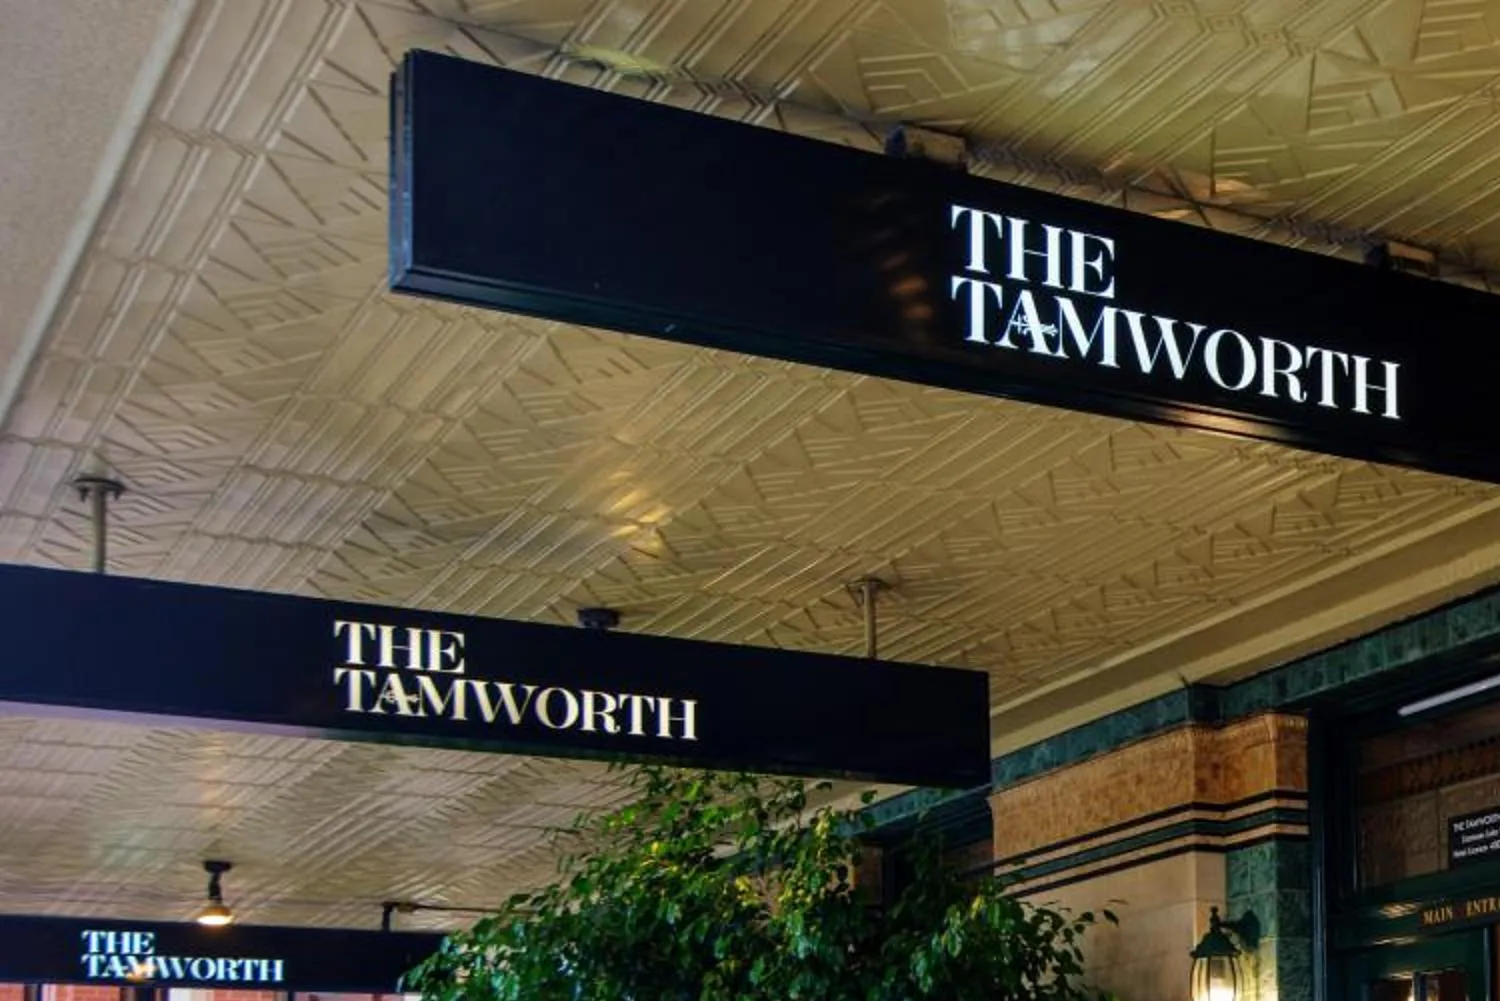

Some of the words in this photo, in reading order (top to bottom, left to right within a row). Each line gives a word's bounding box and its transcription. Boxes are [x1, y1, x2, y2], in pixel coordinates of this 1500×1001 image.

[951, 205, 1115, 299] THE
[951, 275, 1401, 421] TAMWORTH
[334, 620, 465, 674] THE
[334, 667, 698, 741] TAMWORTH
[82, 929, 156, 955] THE
[1422, 906, 1454, 925] MAIN
[82, 954, 285, 983] TAMWORTH
